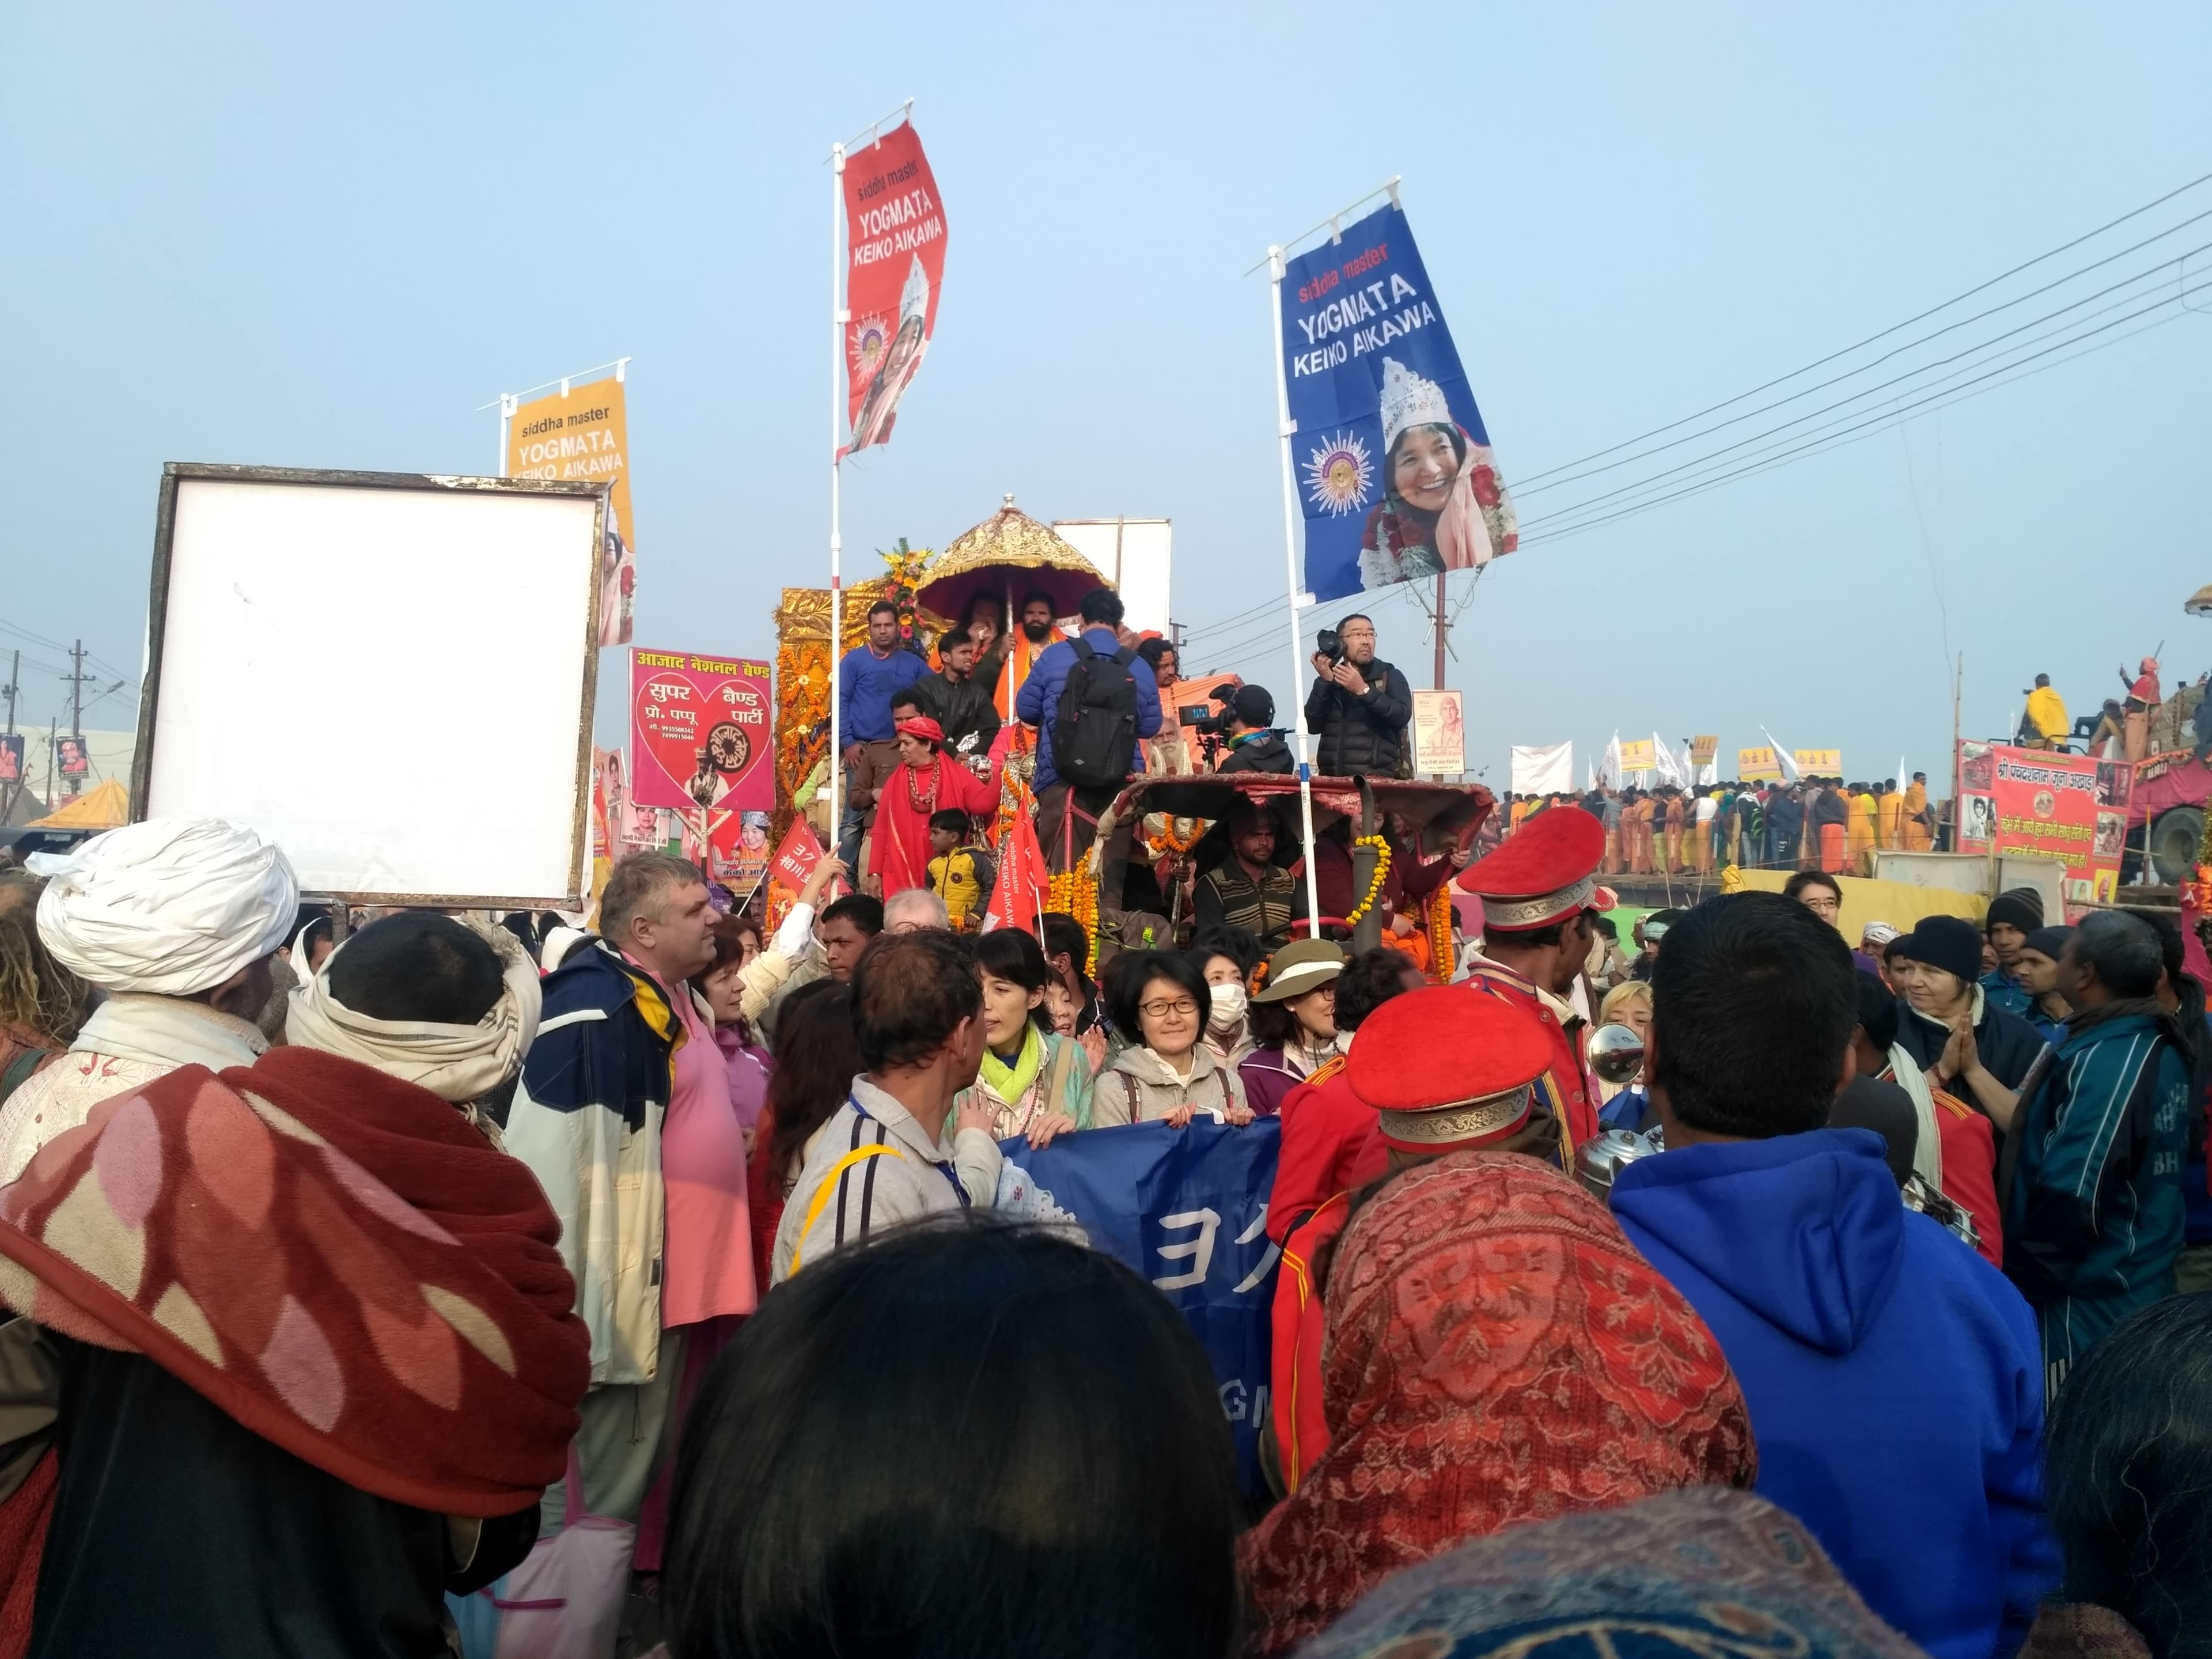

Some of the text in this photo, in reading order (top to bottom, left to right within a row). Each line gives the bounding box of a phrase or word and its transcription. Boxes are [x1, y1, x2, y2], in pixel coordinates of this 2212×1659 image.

[858, 159, 918, 202] siddha master
[859, 186, 932, 238] YOGMATA
[854, 215, 942, 267] KEIKO AIKAWA
[1299, 243, 1389, 304] siddha master
[1298, 272, 1417, 345] YOGMATA
[1294, 301, 1437, 378] KEIKO AIKAWA
[522, 406, 610, 438] siddha master
[519, 429, 616, 467] YOGMATA
[563, 453, 623, 479] AIKAWA
[637, 652, 771, 679] आजाद नेशनल बैण्ड
[649, 683, 691, 703] सुपर
[722, 686, 759, 706] बैण्ड
[645, 704, 699, 726] प्रो. पप्पू
[731, 709, 763, 725] पार्टी
[1997, 757, 2009, 779] श्री
[2051, 770, 2068, 791] जूना
[1002, 859, 1010, 889] KEIKO
